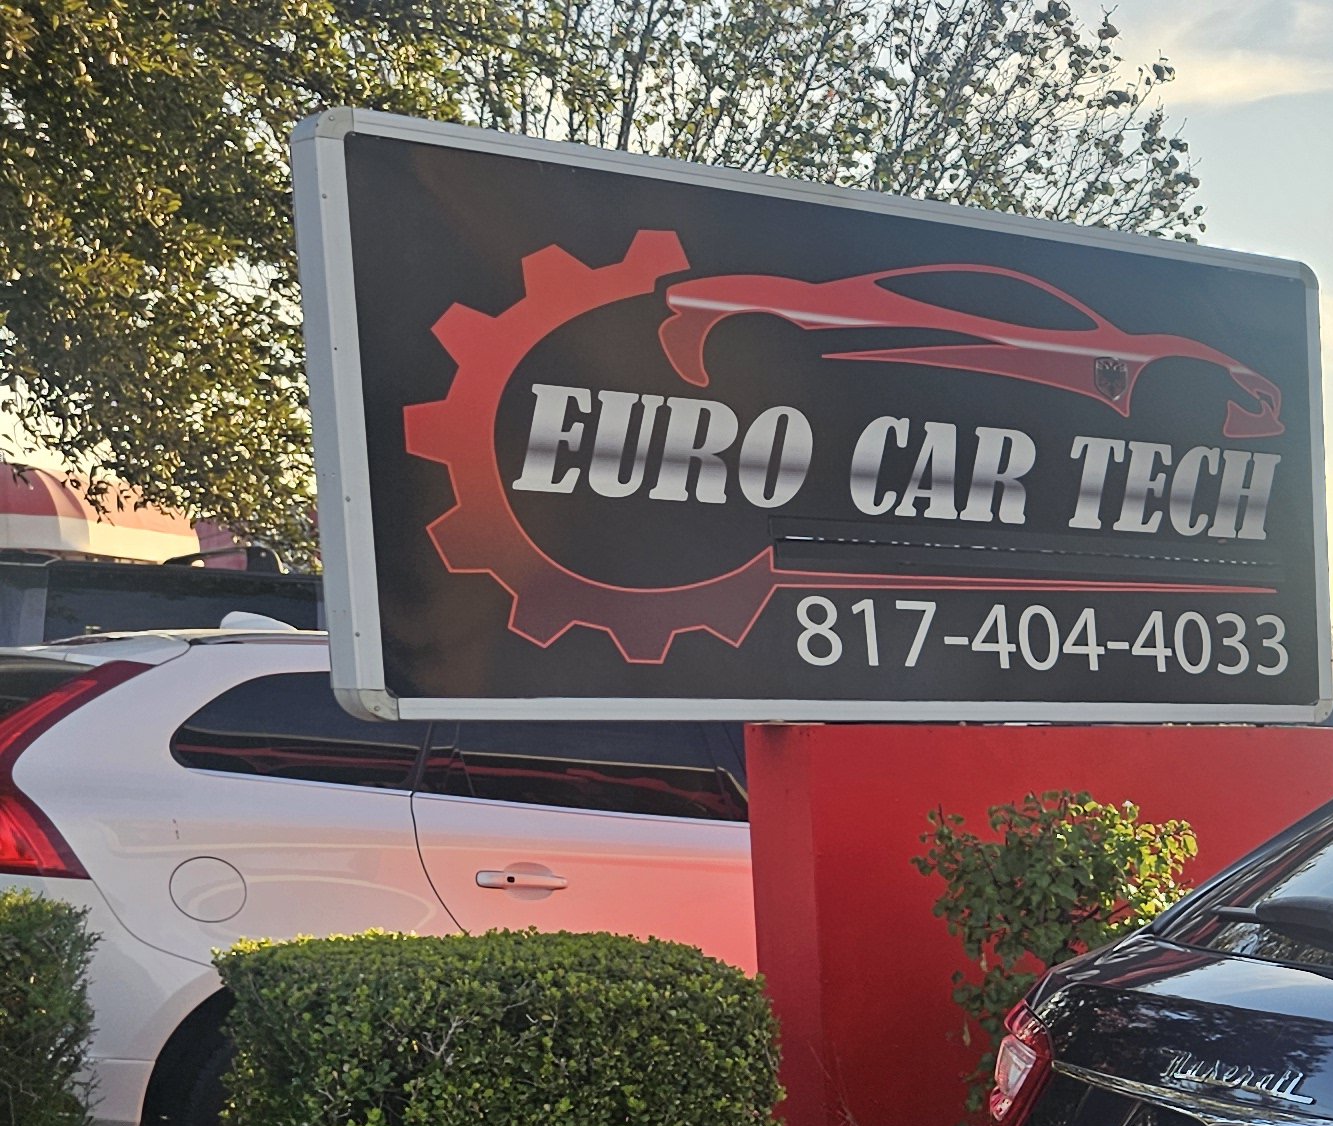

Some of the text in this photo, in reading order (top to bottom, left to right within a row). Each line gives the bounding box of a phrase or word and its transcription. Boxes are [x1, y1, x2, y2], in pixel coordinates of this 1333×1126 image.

[512, 383, 1282, 540] EURO CAR TECH
[796, 594, 1289, 676] 817-404-4033
